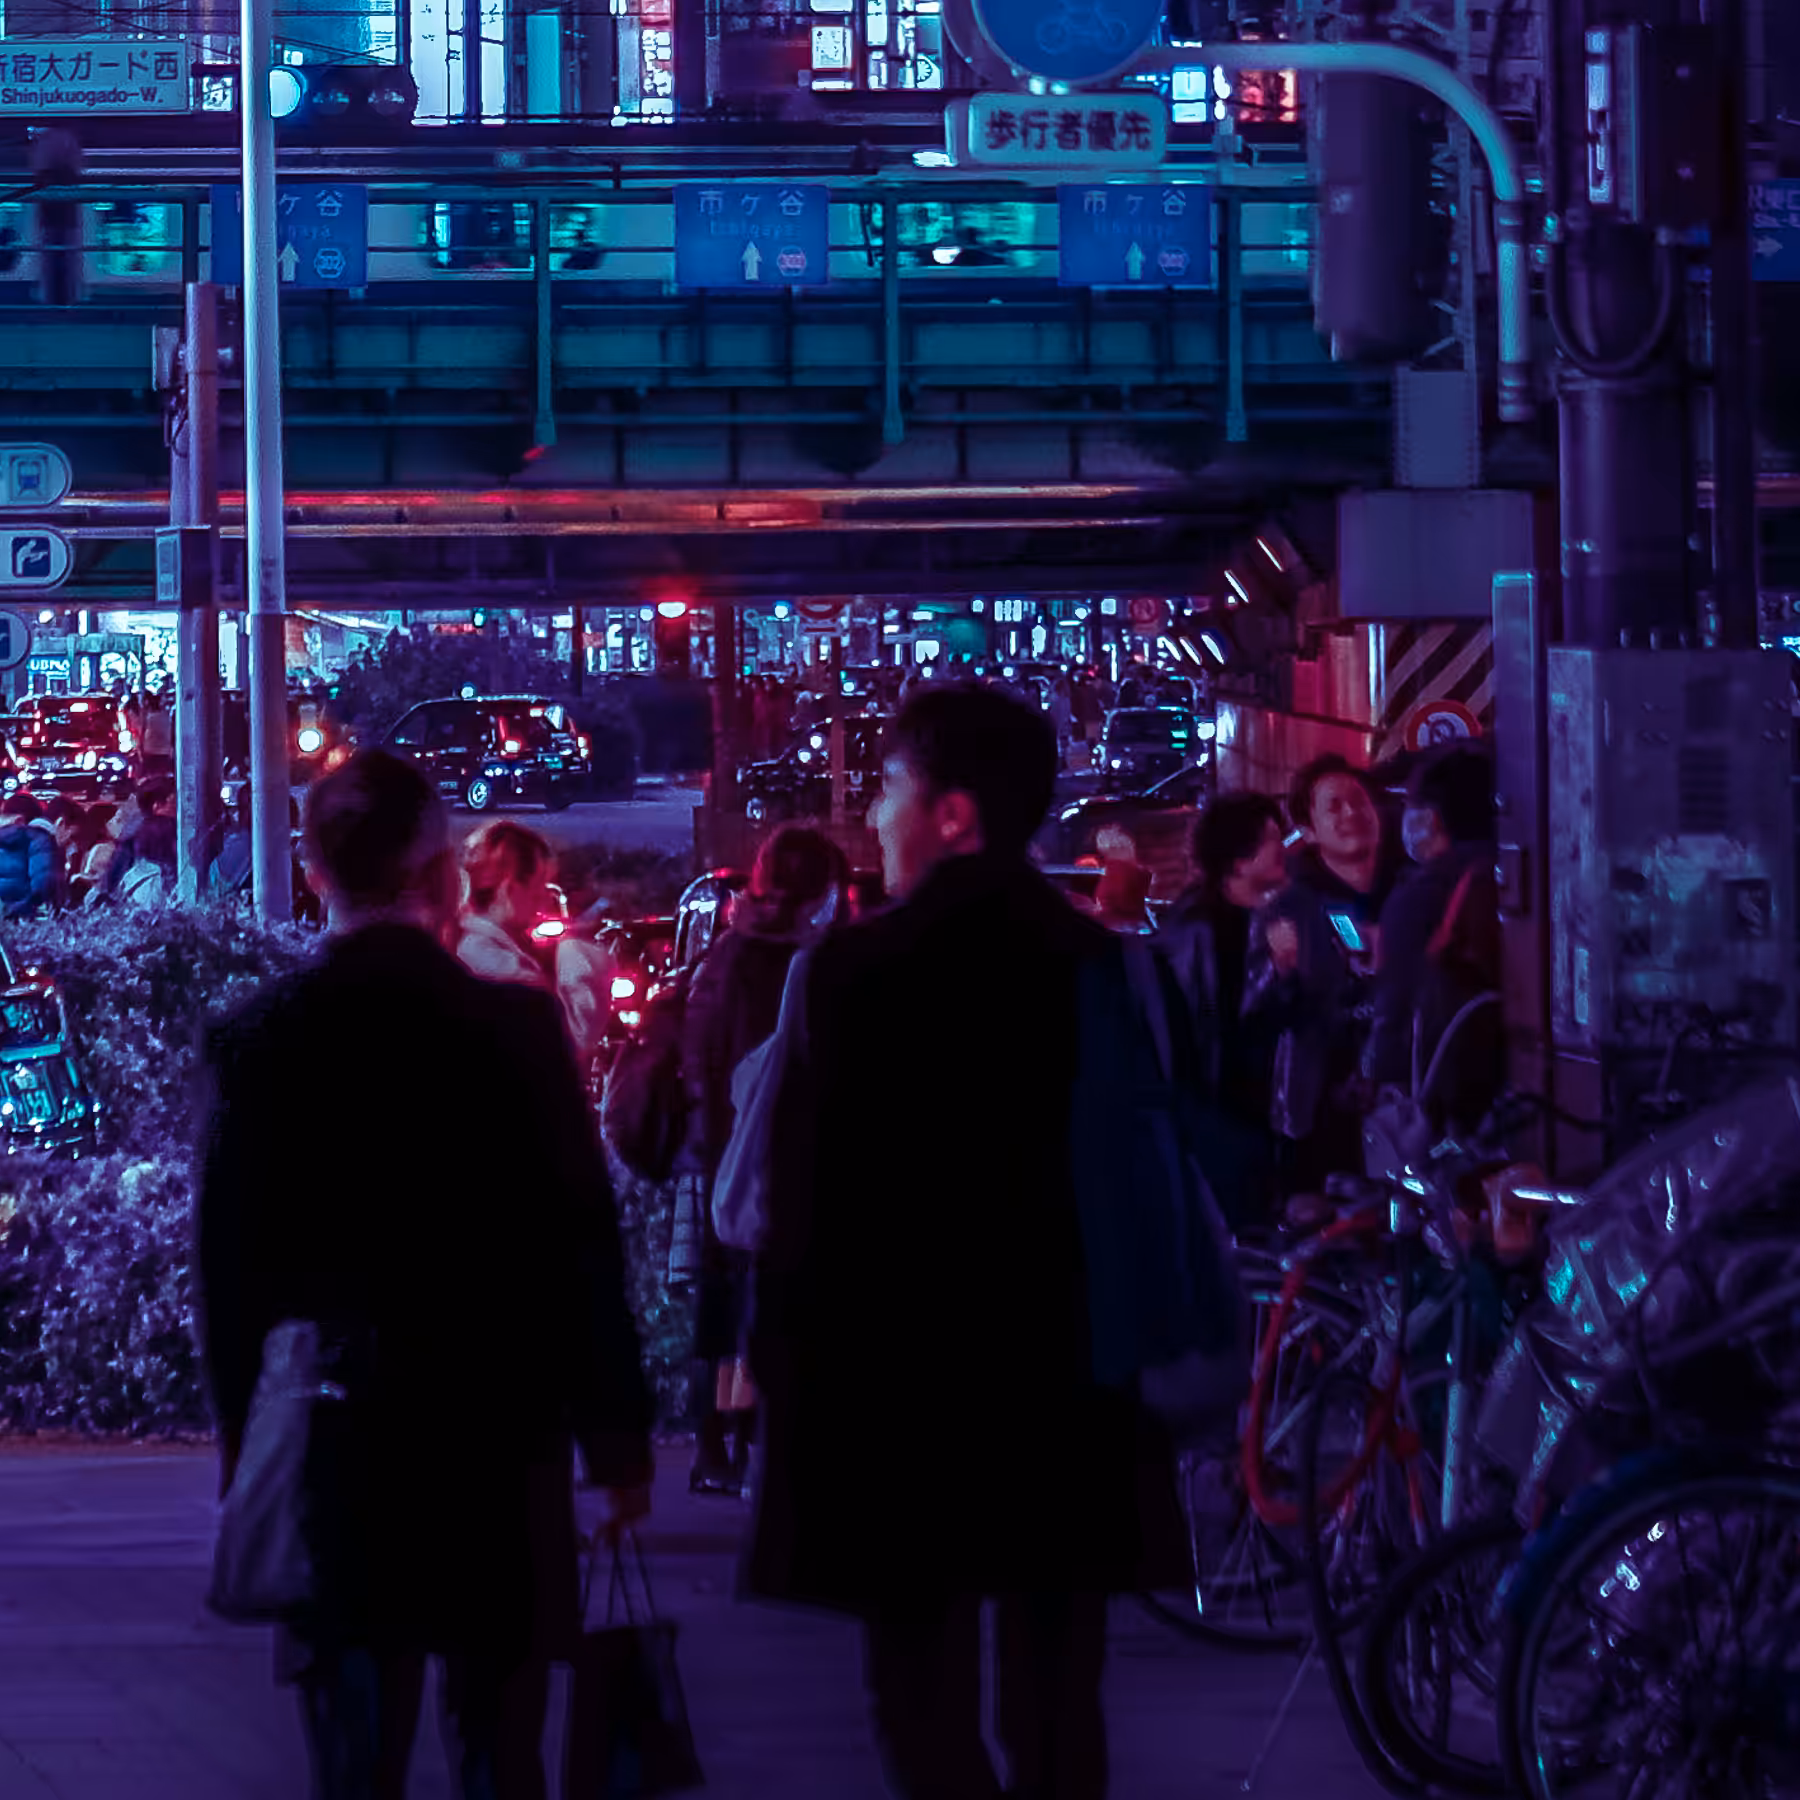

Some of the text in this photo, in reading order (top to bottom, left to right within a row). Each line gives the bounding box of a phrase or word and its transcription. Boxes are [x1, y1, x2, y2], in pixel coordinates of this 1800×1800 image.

[984, 108, 1154, 154] 歩行者優先
